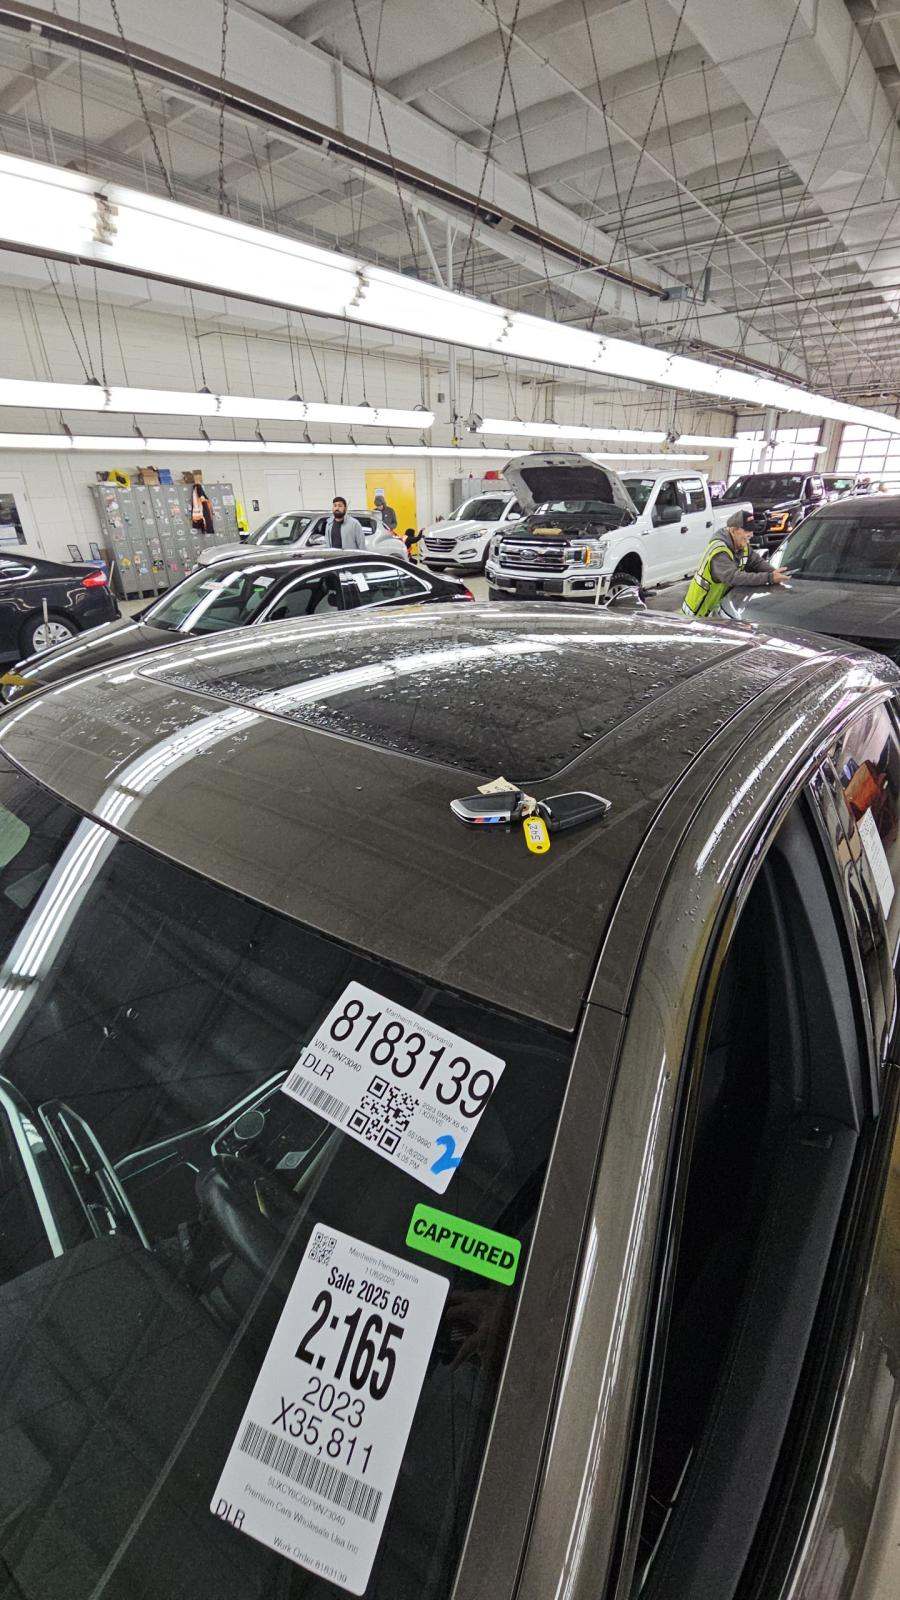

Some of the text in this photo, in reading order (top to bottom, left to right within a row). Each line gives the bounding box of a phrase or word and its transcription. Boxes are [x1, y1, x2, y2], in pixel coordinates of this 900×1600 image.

[384, 1007, 454, 1049] Manheim Pennsylvania
[301, 1052, 335, 1080] DLR
[326, 1047, 362, 1072] P9N73040
[330, 999, 495, 1119] 8183139
[430, 1134, 462, 1174] 2
[412, 1218, 516, 1272] CAPTURED
[326, 1265, 410, 1320] Sale 2025 69
[294, 1290, 404, 1401] 2:165
[302, 1376, 366, 1429] 2023
[271, 1396, 374, 1475] X35,811
[272, 1535, 291, 1553] Work
